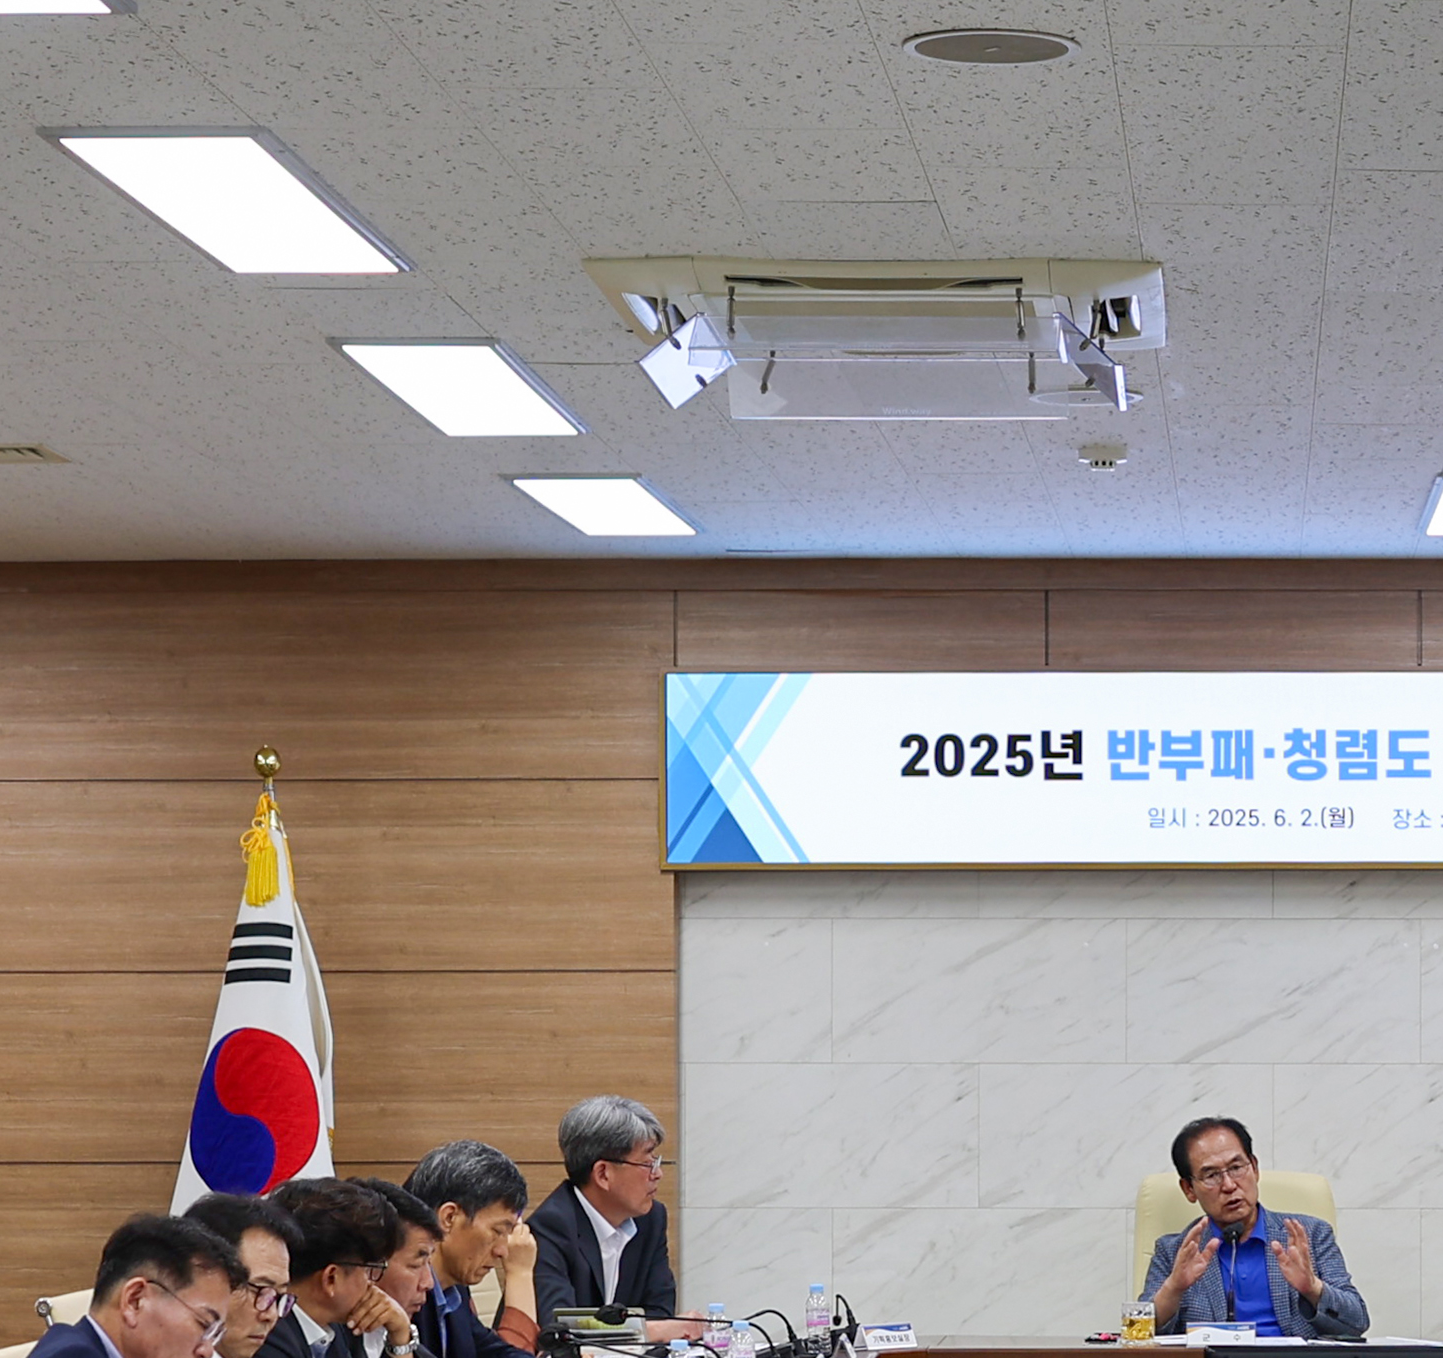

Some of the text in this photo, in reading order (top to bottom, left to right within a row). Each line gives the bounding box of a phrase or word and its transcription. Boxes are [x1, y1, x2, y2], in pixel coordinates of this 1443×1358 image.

[900, 730, 1083, 782] 2025년
[1107, 728, 1431, 782] 반부패·청렴도
[1148, 808, 1186, 829] 일시
[1208, 808, 1266, 827] 2025.
[1273, 808, 1293, 827] 6.
[1300, 807, 1355, 829] 2.(월)
[1393, 808, 1432, 830] 장소
